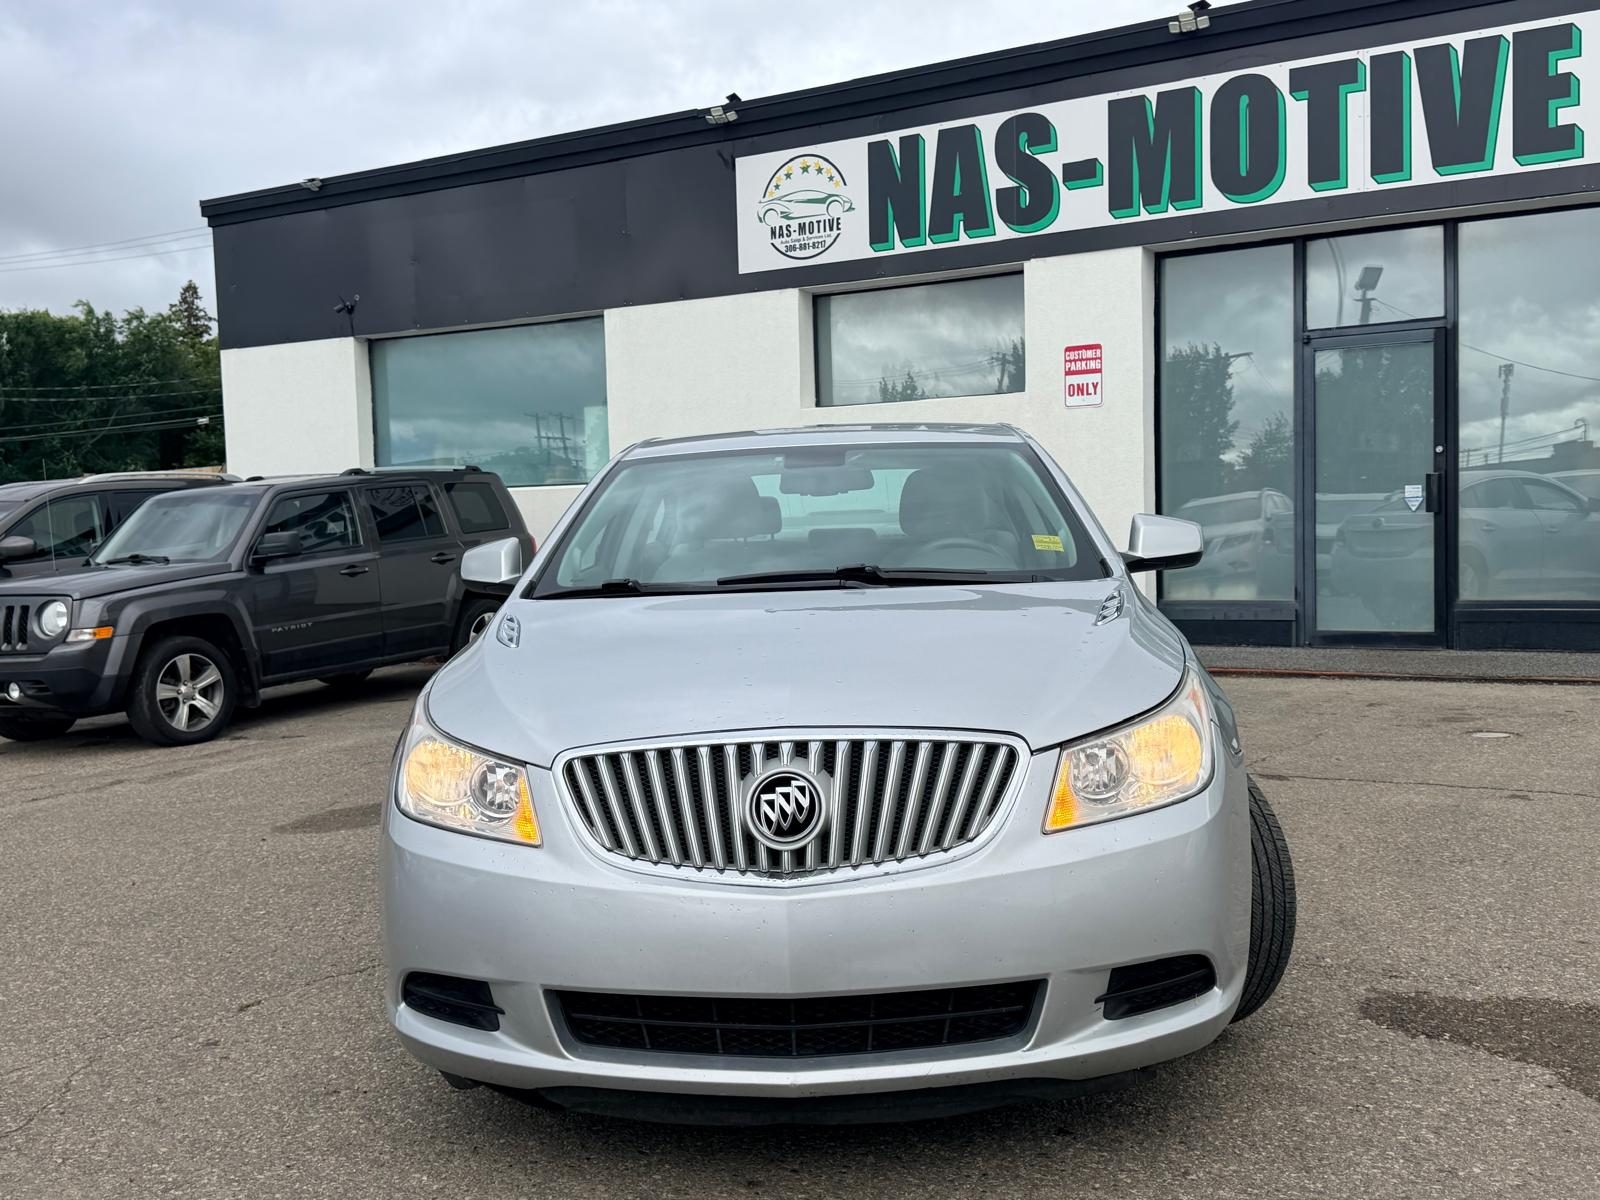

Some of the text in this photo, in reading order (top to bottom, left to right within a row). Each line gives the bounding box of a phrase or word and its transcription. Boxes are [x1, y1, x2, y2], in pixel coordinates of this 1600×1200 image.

[867, 22, 1584, 253] NAS-MOTIVE
[770, 217, 841, 240] NAS-MOTIVE
[1065, 349, 1101, 360] CUSTOMER
[1065, 359, 1101, 372] PARKING
[1068, 382, 1099, 397] ONLY
[271, 622, 313, 633] PATRIOT
